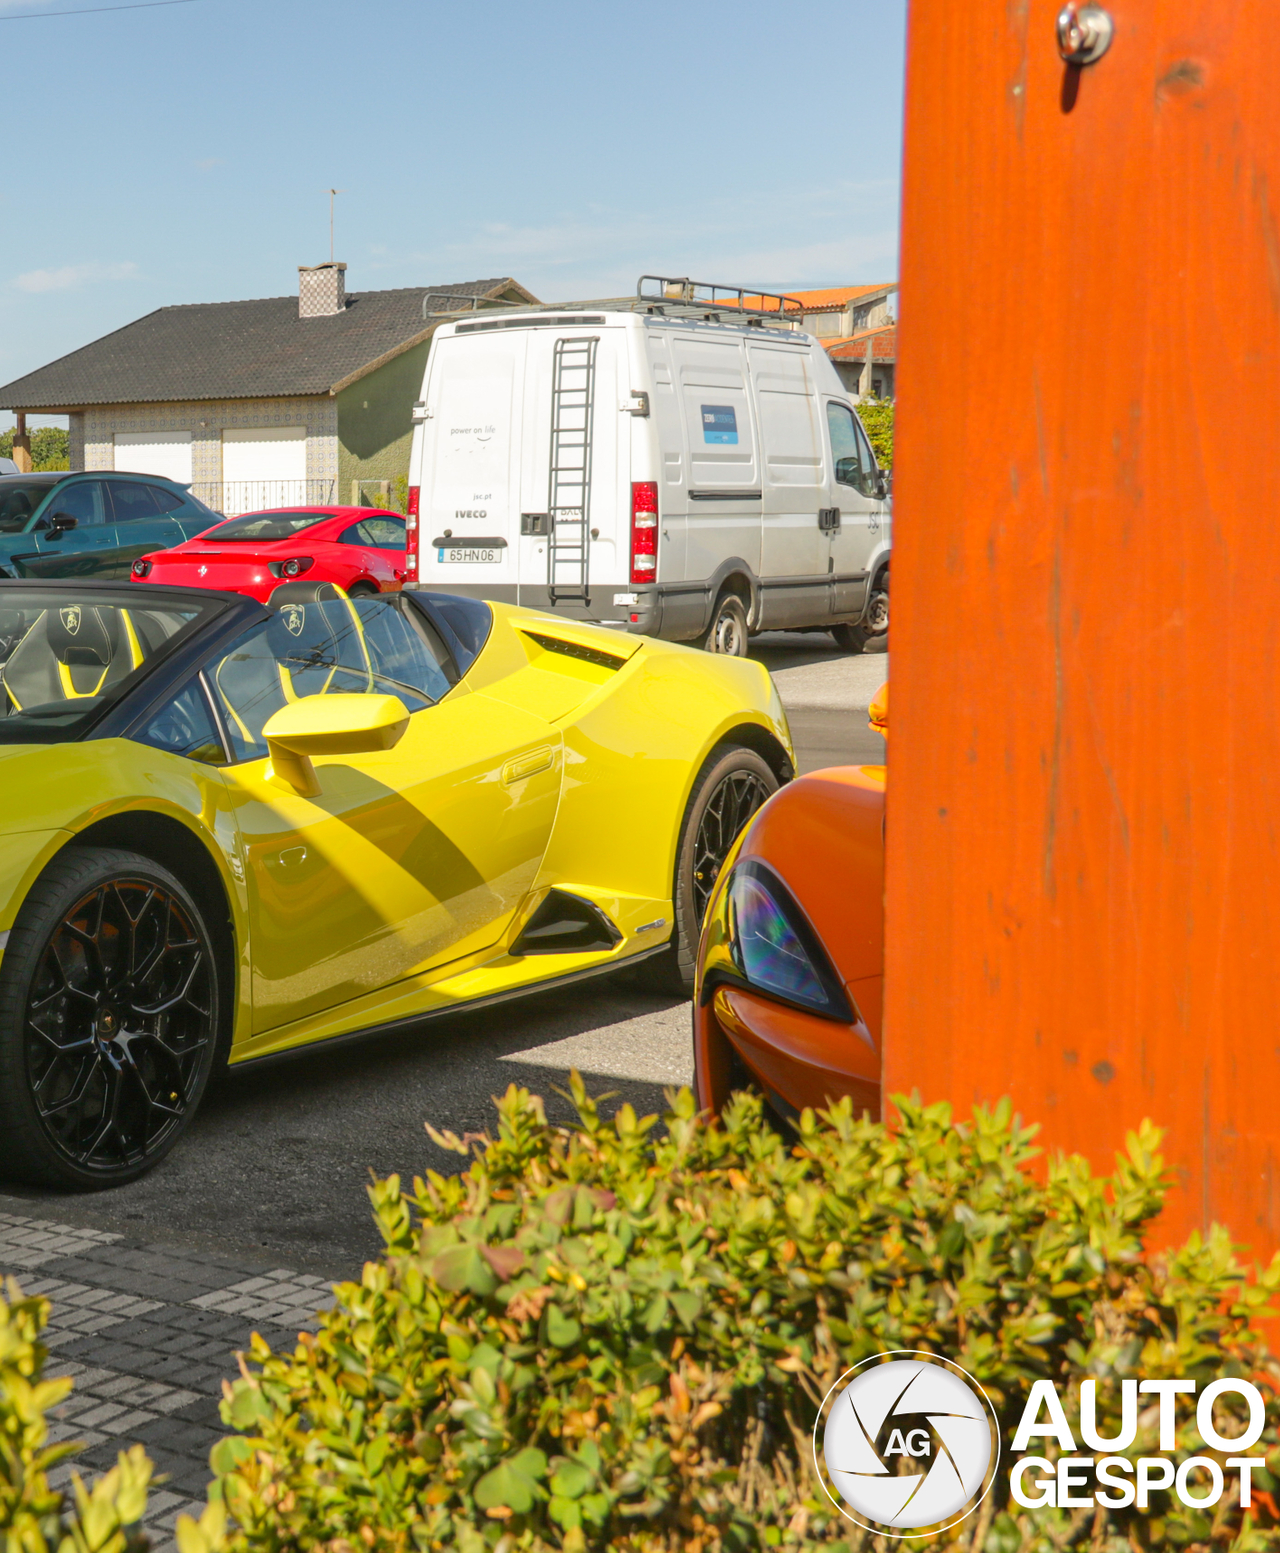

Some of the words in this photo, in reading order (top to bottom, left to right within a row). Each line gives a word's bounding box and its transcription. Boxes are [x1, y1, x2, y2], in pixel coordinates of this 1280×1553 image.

[450, 428, 472, 436] power
[484, 424, 496, 434] life
[473, 493, 492, 501] jsc.pt
[455, 510, 487, 519] IVECO
